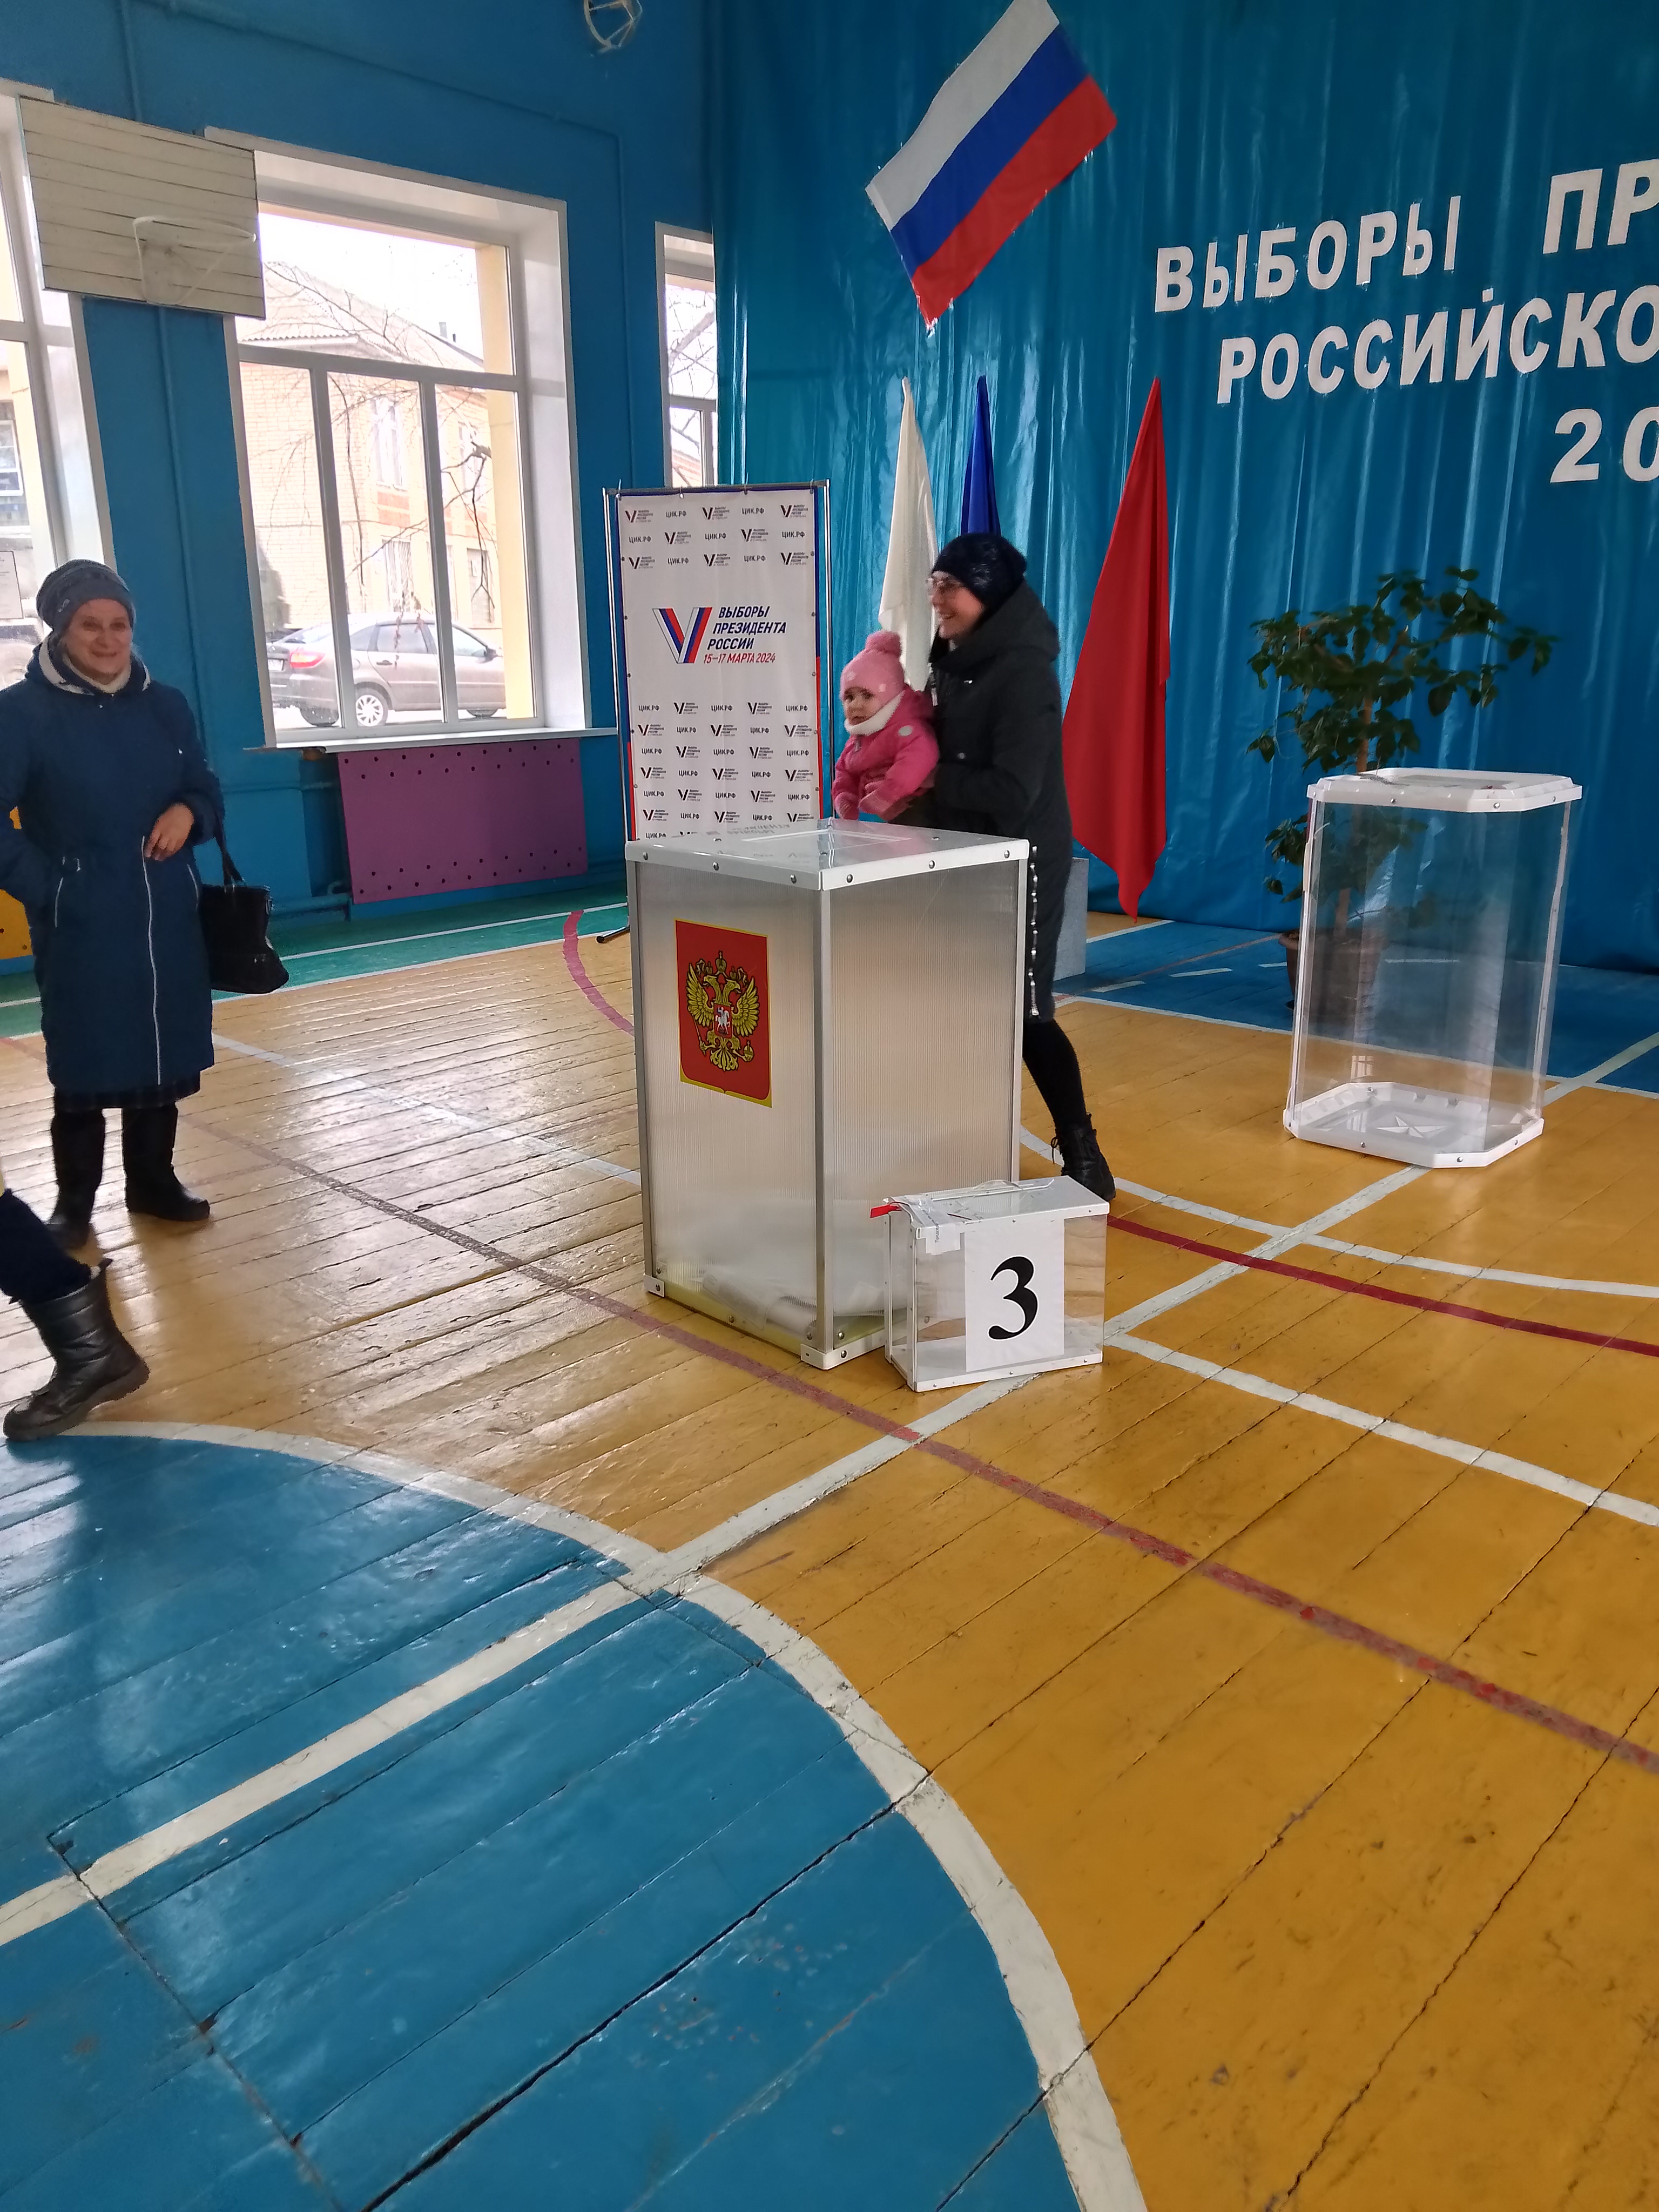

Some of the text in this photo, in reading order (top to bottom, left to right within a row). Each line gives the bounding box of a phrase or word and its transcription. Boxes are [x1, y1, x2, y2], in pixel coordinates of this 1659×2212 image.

[1154, 158, 1659, 312] ВЫБОРЫ ПР
[1217, 285, 1659, 404] РОССИЙСКО
[1550, 406, 1659, 483] 20
[665, 510, 687, 518] ЦИК.РФ
[741, 507, 765, 515] ЦИК.РФ
[705, 532, 726, 541] ЦИК.РФ
[781, 531, 805, 539] ЦИК.РФ
[629, 536, 651, 544] ЦИК.РФ
[667, 557, 689, 566] ЦИК.РФ
[744, 555, 766, 563] ЦИК.РФ
[718, 606, 770, 618] ВЫБОРЫ
[713, 622, 786, 635] ПРЕЗИДЕНТА
[707, 638, 754, 650] РОССИИ
[727, 652, 754, 663] МАРТА
[756, 652, 775, 663] 2024
[678, 770, 698, 778] ЦИК.РФ
[751, 771, 771, 779] ЦИК.РФ
[988, 1256, 1038, 1340] 3
